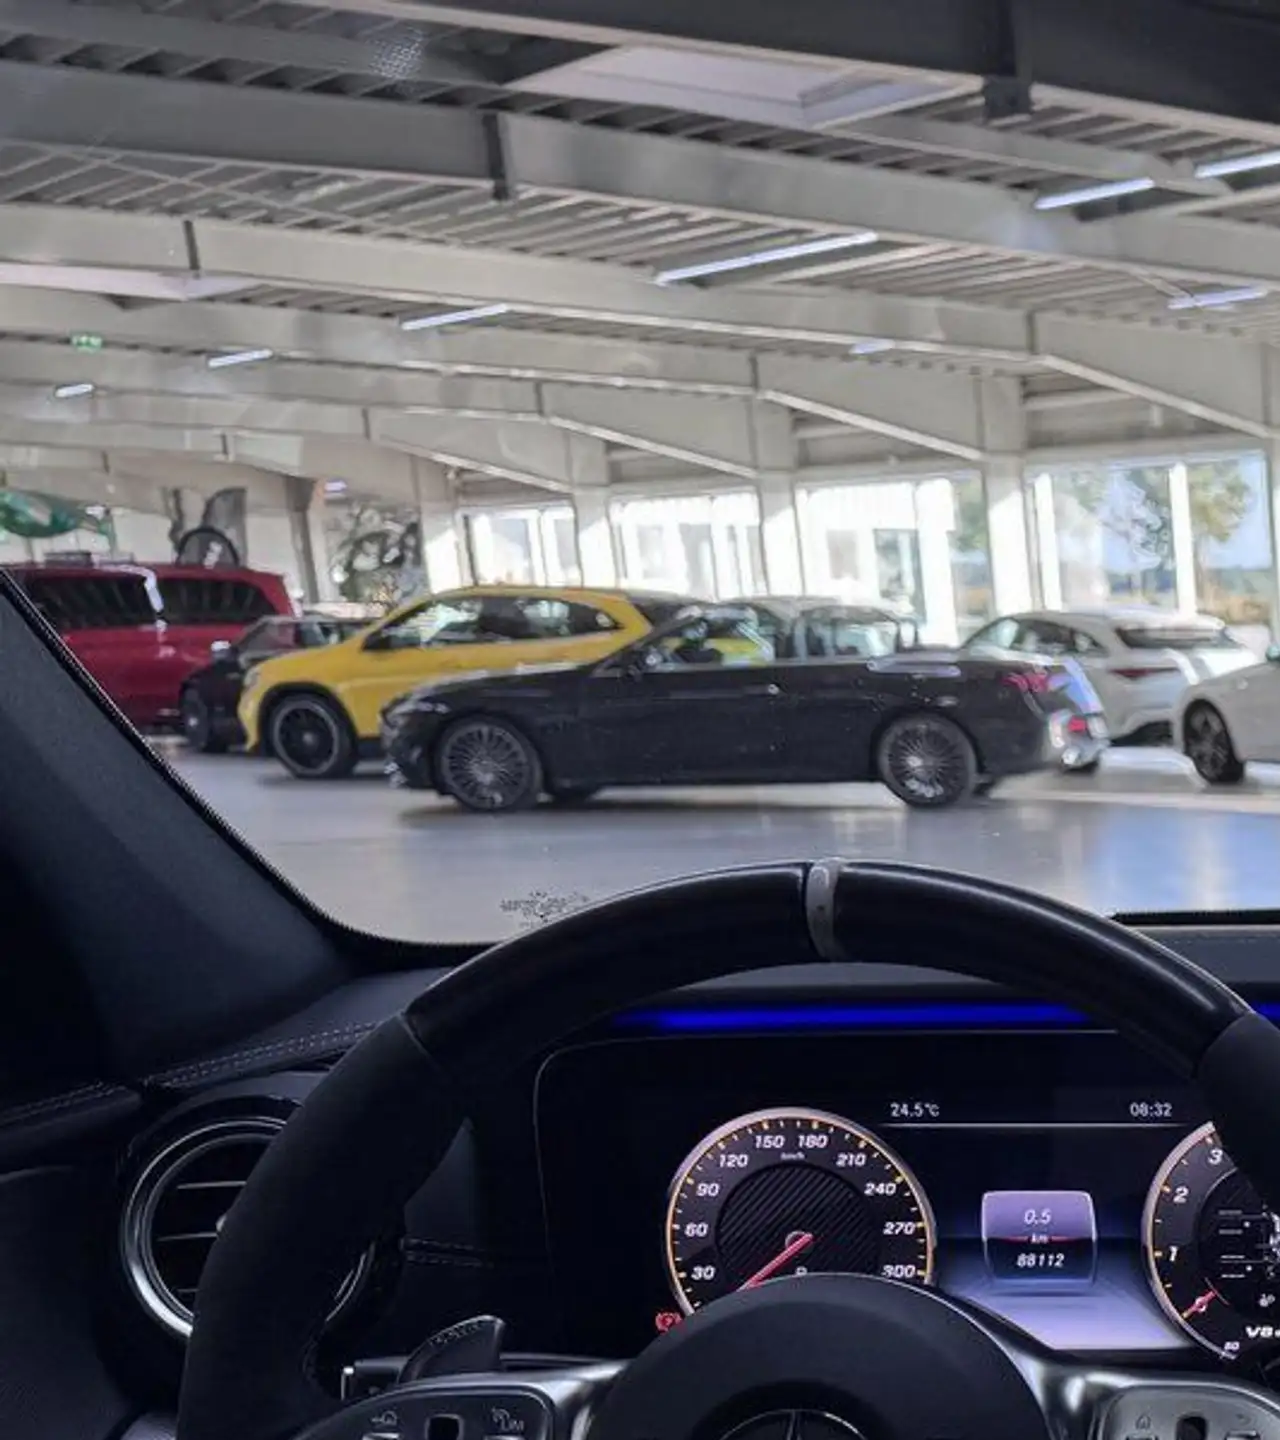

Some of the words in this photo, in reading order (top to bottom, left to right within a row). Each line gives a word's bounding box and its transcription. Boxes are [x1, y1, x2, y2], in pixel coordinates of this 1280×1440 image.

[1129, 1102, 1173, 1117] 08:32
[754, 1134, 785, 1149] 150
[798, 1134, 829, 1149] 180
[718, 1153, 749, 1168] 120
[835, 1153, 867, 1167] 210
[1208, 1149, 1223, 1164] 3
[696, 1183, 720, 1197] 90
[864, 1183, 896, 1196] 240
[1173, 1187, 1189, 1203] 2
[1024, 1209, 1052, 1225] 0.5
[684, 1223, 708, 1237] 60
[883, 1223, 916, 1236] 270
[1016, 1253, 1064, 1268] 88112
[1169, 1246, 1179, 1262] 1
[691, 1266, 715, 1280] 30
[881, 1265, 916, 1279] 300
